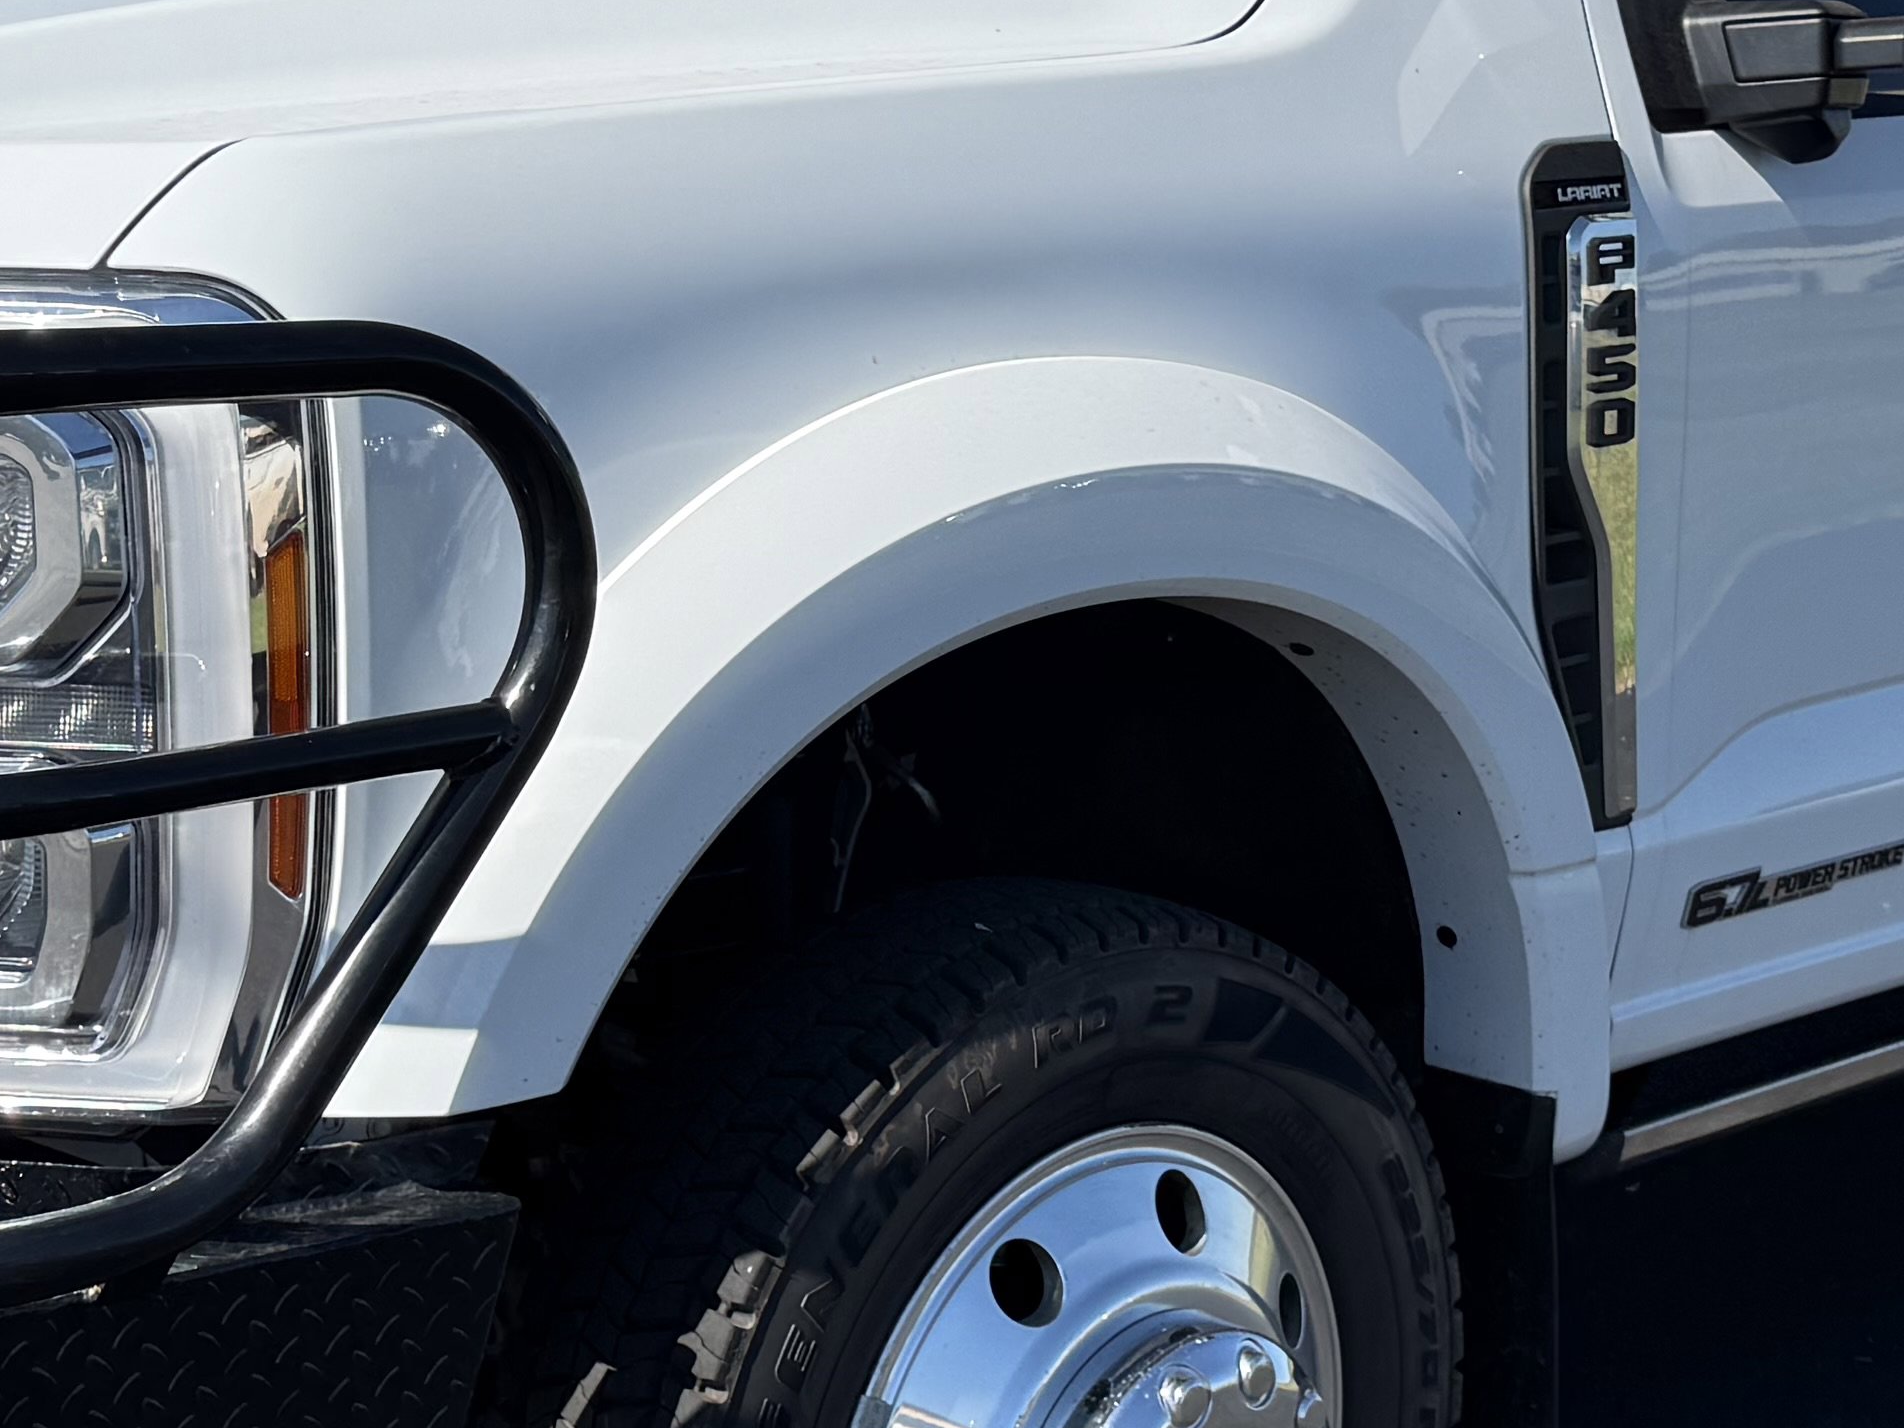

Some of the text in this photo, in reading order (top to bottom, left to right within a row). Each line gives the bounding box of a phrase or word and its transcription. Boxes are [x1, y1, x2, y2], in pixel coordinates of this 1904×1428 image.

[1556, 182, 1623, 203] LARIAT
[1584, 234, 1636, 448] F450
[1683, 868, 1771, 928] 6.7L
[1773, 862, 1837, 898] POWER
